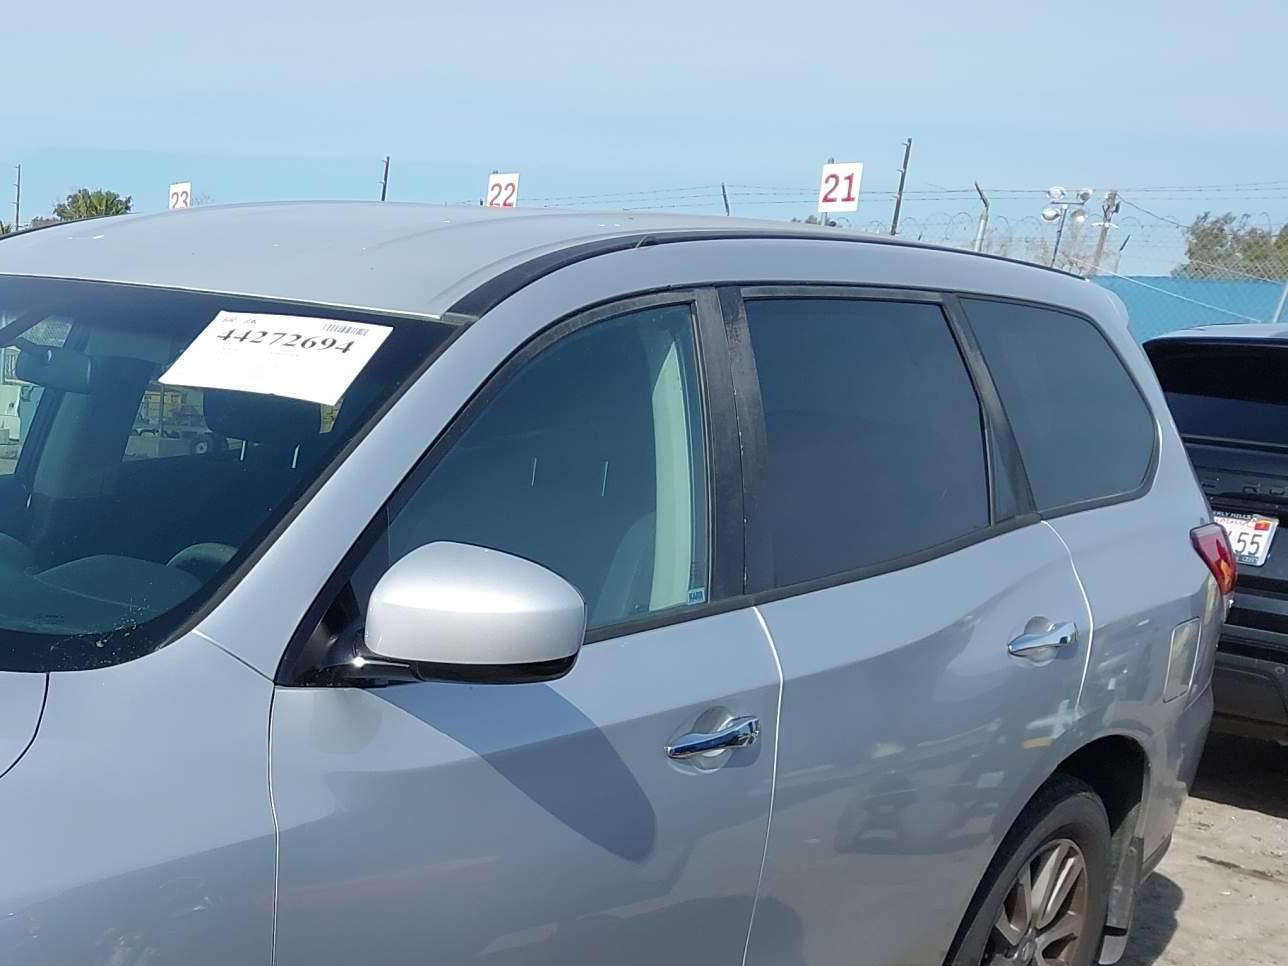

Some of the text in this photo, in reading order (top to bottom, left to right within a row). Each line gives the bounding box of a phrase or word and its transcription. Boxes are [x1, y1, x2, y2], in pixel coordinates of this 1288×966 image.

[171, 190, 189, 209] 23
[489, 182, 516, 207] 22
[822, 173, 855, 202] 21
[217, 328, 354, 354] 44272694
[1227, 531, 1263, 556] 55
